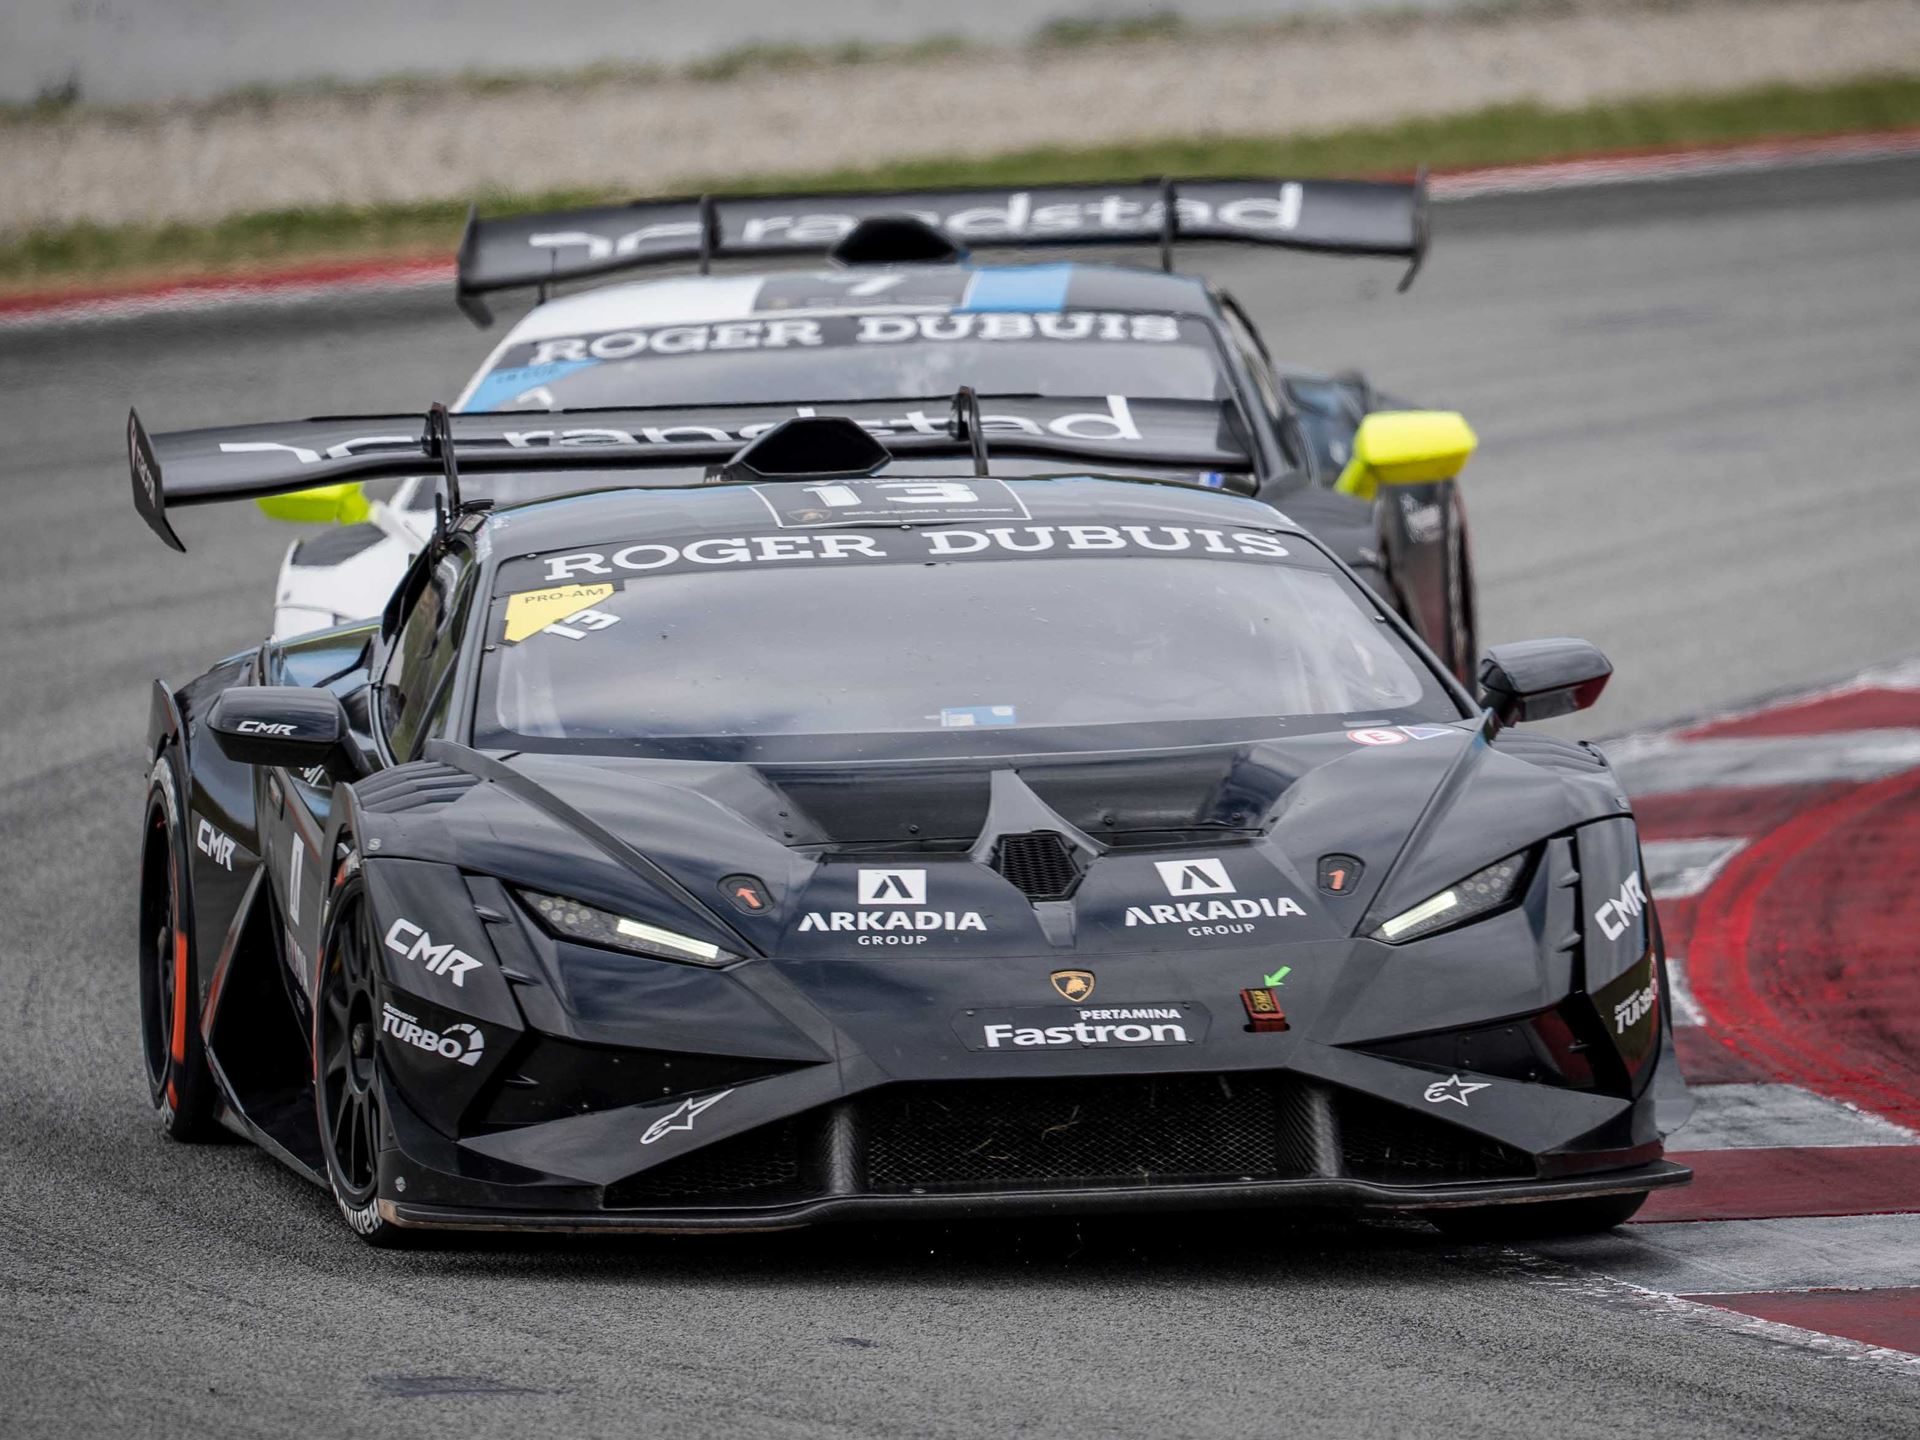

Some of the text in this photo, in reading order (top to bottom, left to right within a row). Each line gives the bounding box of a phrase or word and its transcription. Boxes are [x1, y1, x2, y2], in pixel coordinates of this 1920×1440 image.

[528, 312, 1180, 365] ROGER DUBUIS
[803, 482, 979, 507] 13
[543, 525, 1290, 581] ROGER DUBUIS
[524, 588, 604, 604] PRO-AM
[543, 608, 621, 641] 13
[236, 720, 298, 736] CMR
[196, 818, 236, 872] CMR
[1125, 897, 1307, 926] ARKADIA
[1594, 871, 1648, 941] CMR
[798, 911, 987, 931] ARKADIA
[1187, 922, 1256, 937] GROUP
[385, 918, 484, 987] CMR
[857, 935, 928, 945] GROUP
[1079, 1008, 1182, 1020] PERTAMINA
[382, 1010, 463, 1058] TURBO
[983, 1022, 1188, 1048] Fastron
